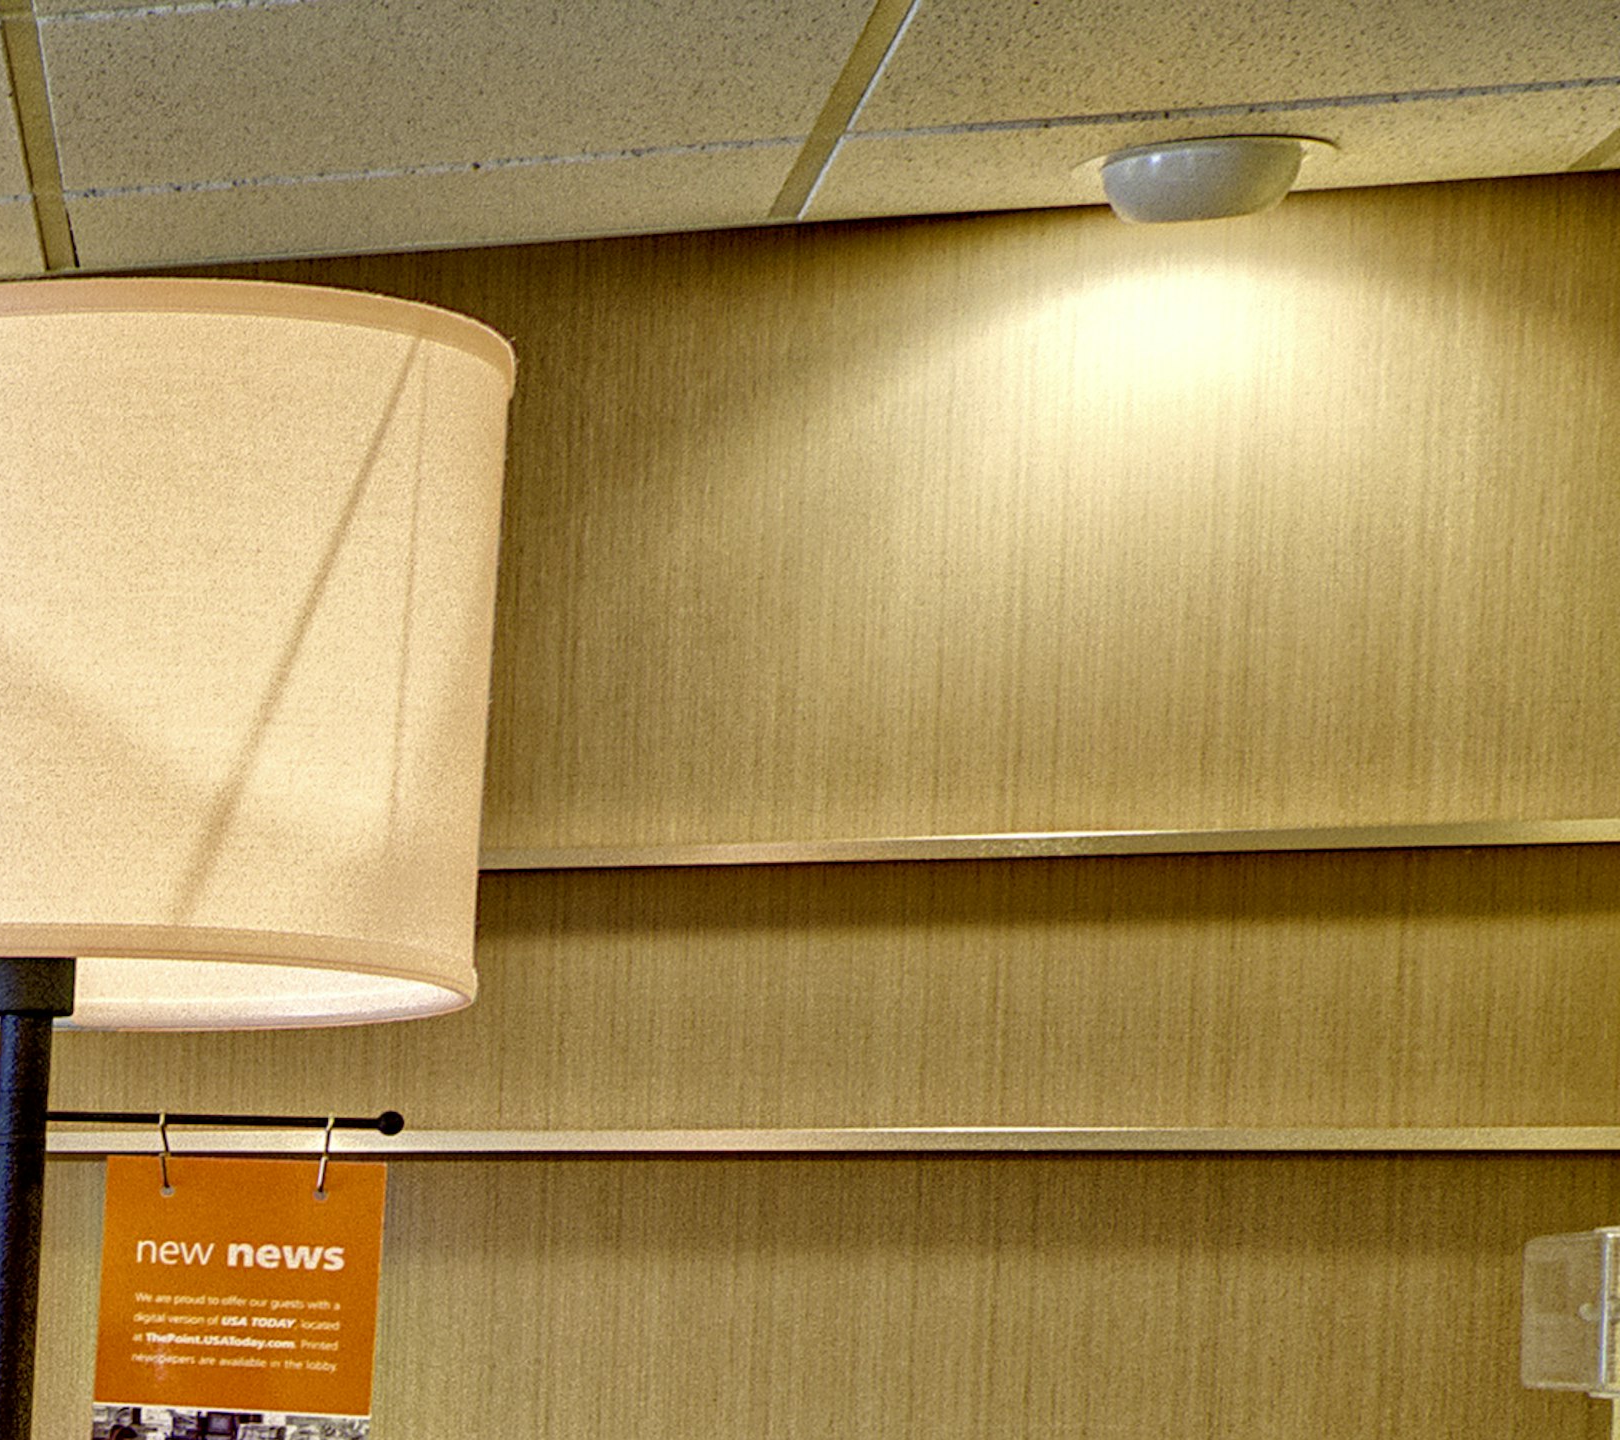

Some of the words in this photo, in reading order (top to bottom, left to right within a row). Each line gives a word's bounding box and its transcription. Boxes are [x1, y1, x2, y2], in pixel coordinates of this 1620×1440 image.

[136, 1239, 215, 1266] new
[227, 1241, 346, 1271] news
[221, 1316, 248, 1327] USA
